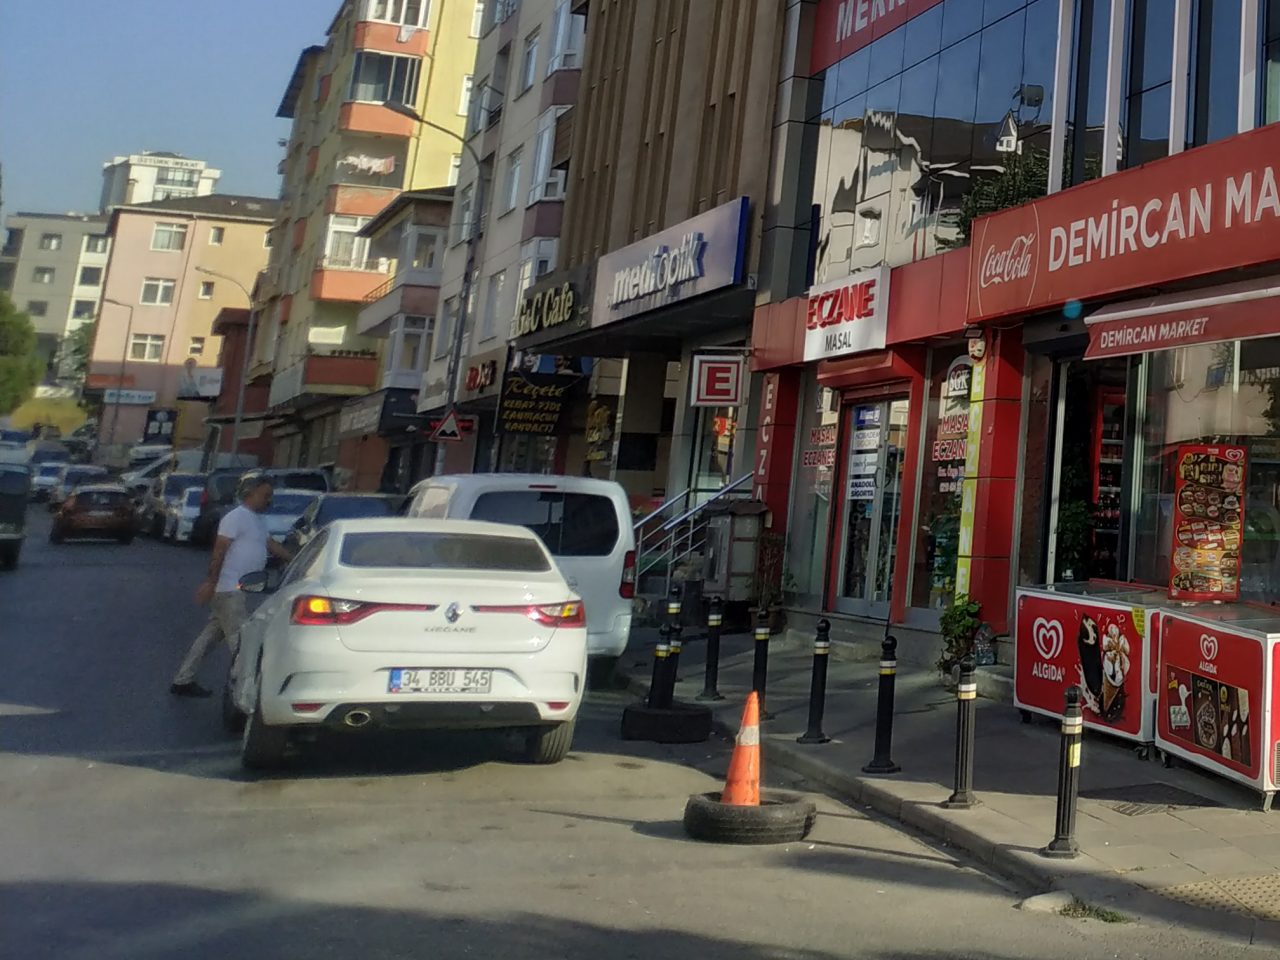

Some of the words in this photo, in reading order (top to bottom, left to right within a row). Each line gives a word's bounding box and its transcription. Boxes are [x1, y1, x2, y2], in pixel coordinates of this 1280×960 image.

[1048, 181, 1212, 272] DEMİRCAN
[981, 233, 1036, 288] Coca-Cola
[806, 278, 876, 330] ECZANE
[825, 330, 852, 352] MASAL
[1100, 324, 1158, 349] DEMİRCAN
[1158, 317, 1209, 341] MARKET
[705, 366, 732, 396] E
[941, 415, 969, 435] MASA
[402, 671, 420, 687] 34
[428, 671, 456, 687] BBU
[463, 671, 489, 687] 545
